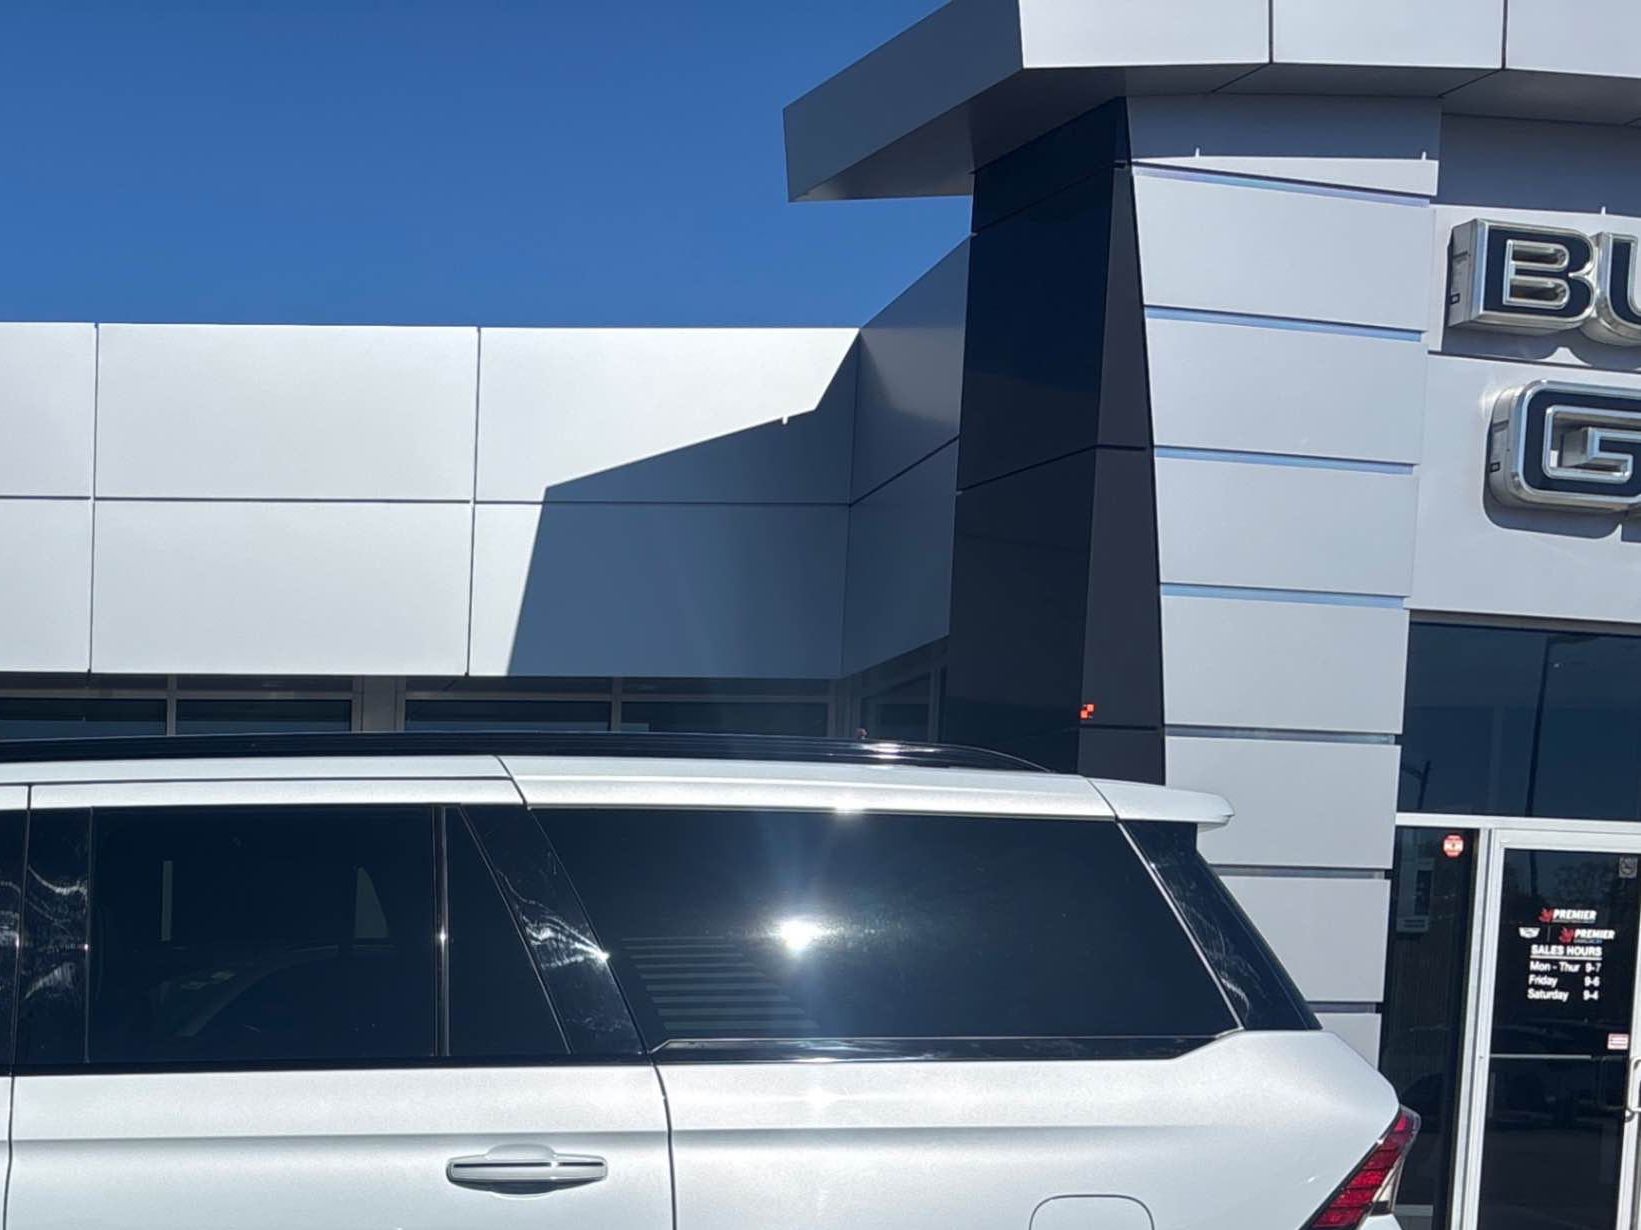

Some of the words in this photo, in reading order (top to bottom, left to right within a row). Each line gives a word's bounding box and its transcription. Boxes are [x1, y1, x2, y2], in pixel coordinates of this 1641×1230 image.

[1553, 909, 1597, 920] PREMIER
[1574, 929, 1616, 940] PREMIER
[1531, 944, 1564, 956] SALES
[1566, 945, 1602, 957] HOURS
[1530, 960, 1551, 971] Mon
[1559, 961, 1581, 973] Thur
[1585, 962, 1602, 973] 9-7
[1528, 974, 1558, 988] Friday
[1584, 976, 1600, 987] 9-6
[1527, 987, 1569, 1003] Saturday
[1583, 989, 1599, 1001] 9-4
